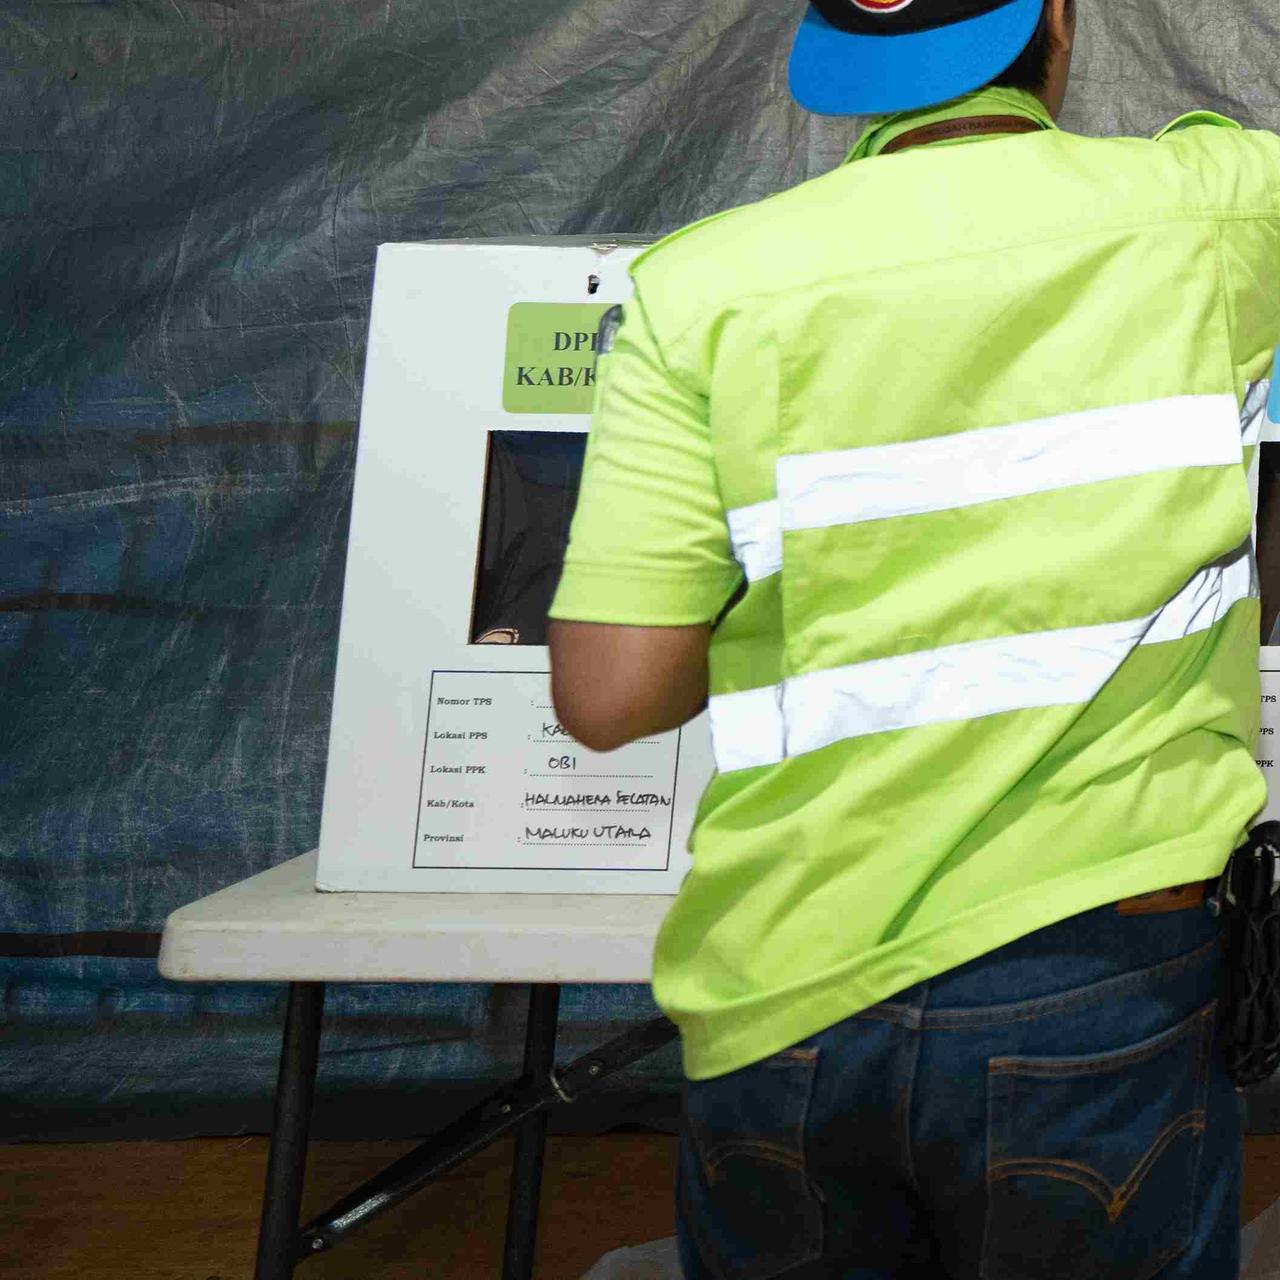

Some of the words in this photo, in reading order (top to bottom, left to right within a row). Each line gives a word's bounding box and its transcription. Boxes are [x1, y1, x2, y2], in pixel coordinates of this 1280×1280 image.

[437, 697, 470, 706] Nomor
[474, 697, 492, 706] TPS
[433, 732, 466, 740] Lokasi
[469, 732, 488, 740] PPS
[548, 757, 576, 770] OBI
[430, 766, 462, 774] Lokasi
[465, 766, 486, 774] PPK
[427, 799, 475, 808] Kab/Kota
[526, 827, 589, 839] MALUKU
[593, 825, 651, 839] UTARA
[423, 834, 464, 842] Provinsi
